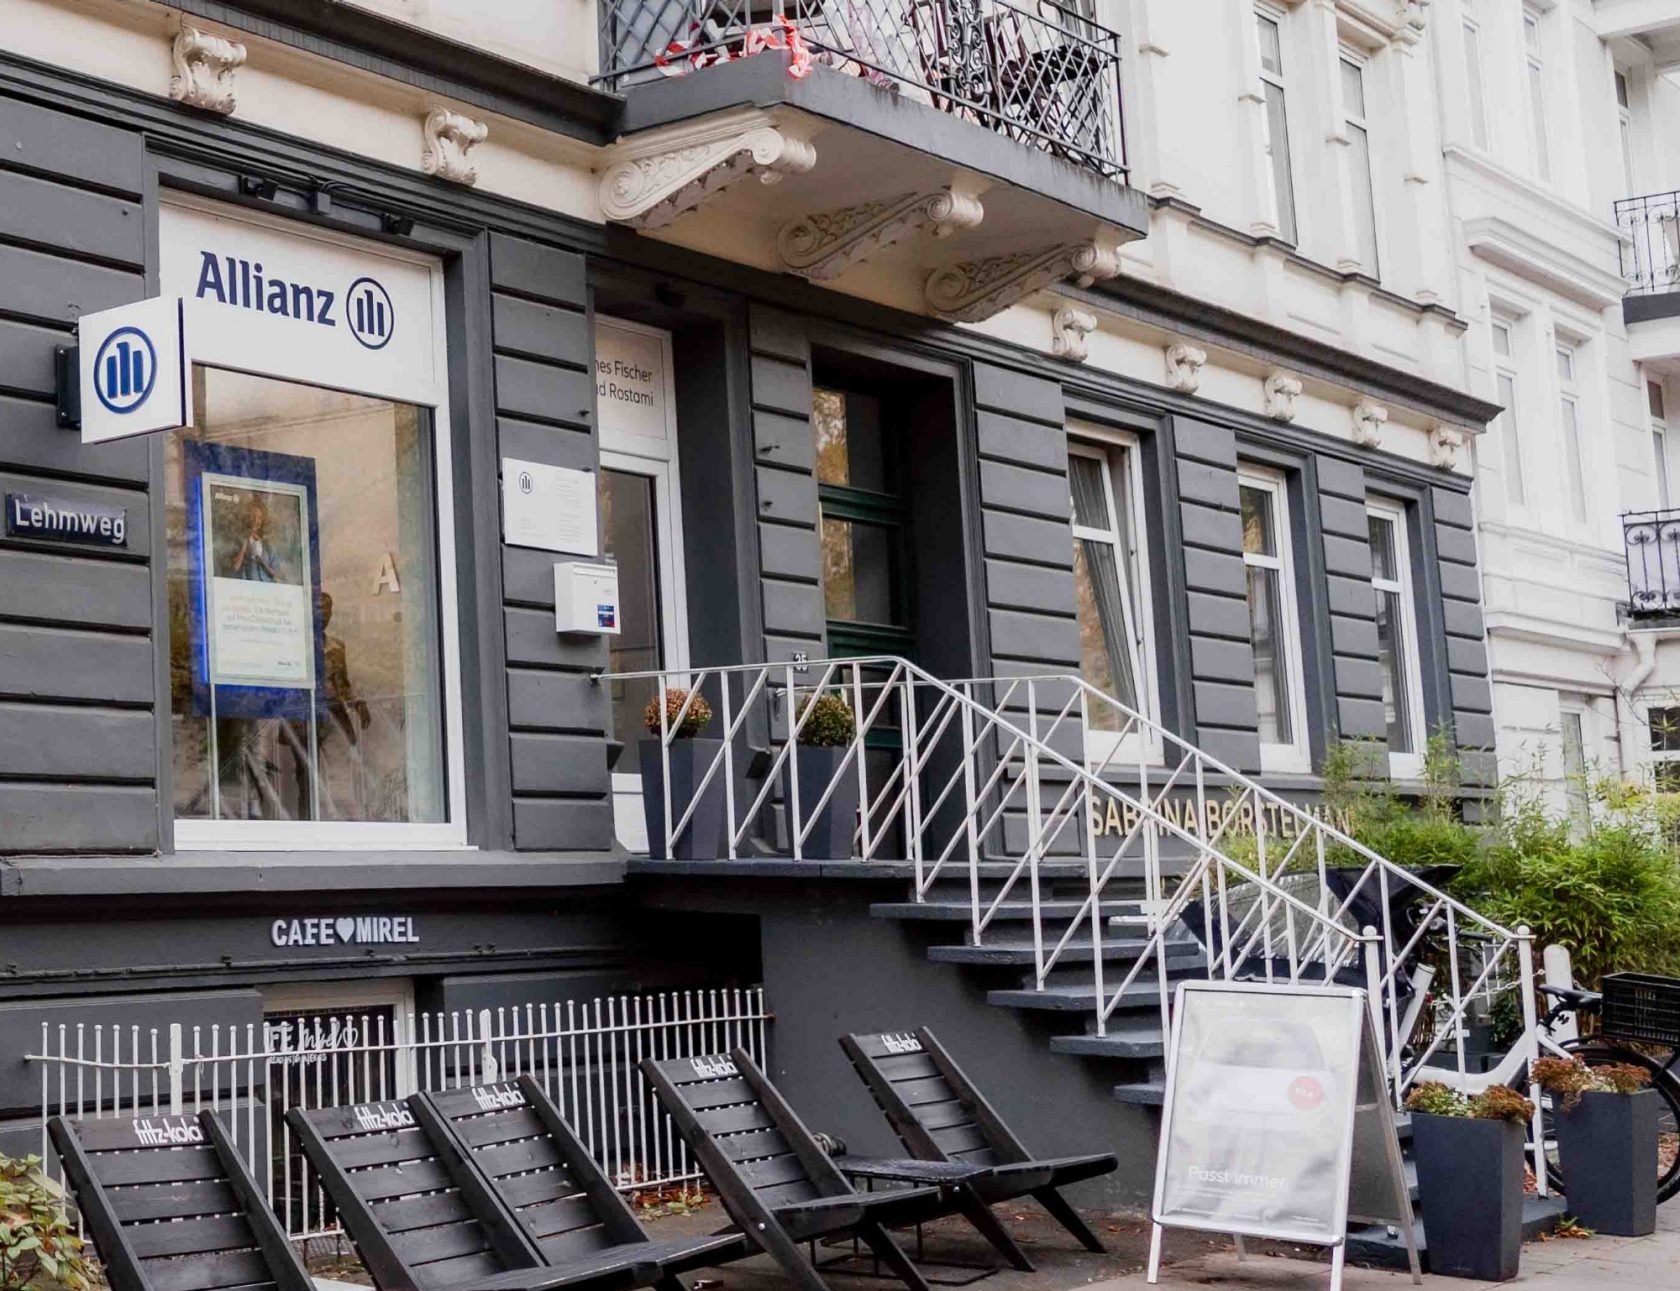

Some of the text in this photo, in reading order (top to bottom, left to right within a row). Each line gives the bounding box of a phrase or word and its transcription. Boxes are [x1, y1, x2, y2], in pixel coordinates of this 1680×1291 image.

[195, 250, 336, 326] Allianz
[614, 361, 653, 382] Fischer
[609, 383, 654, 407] Rostami
[14, 498, 125, 544] Lehmweg
[355, 916, 419, 943] MIREL
[1188, 1165, 1229, 1185] Passt
